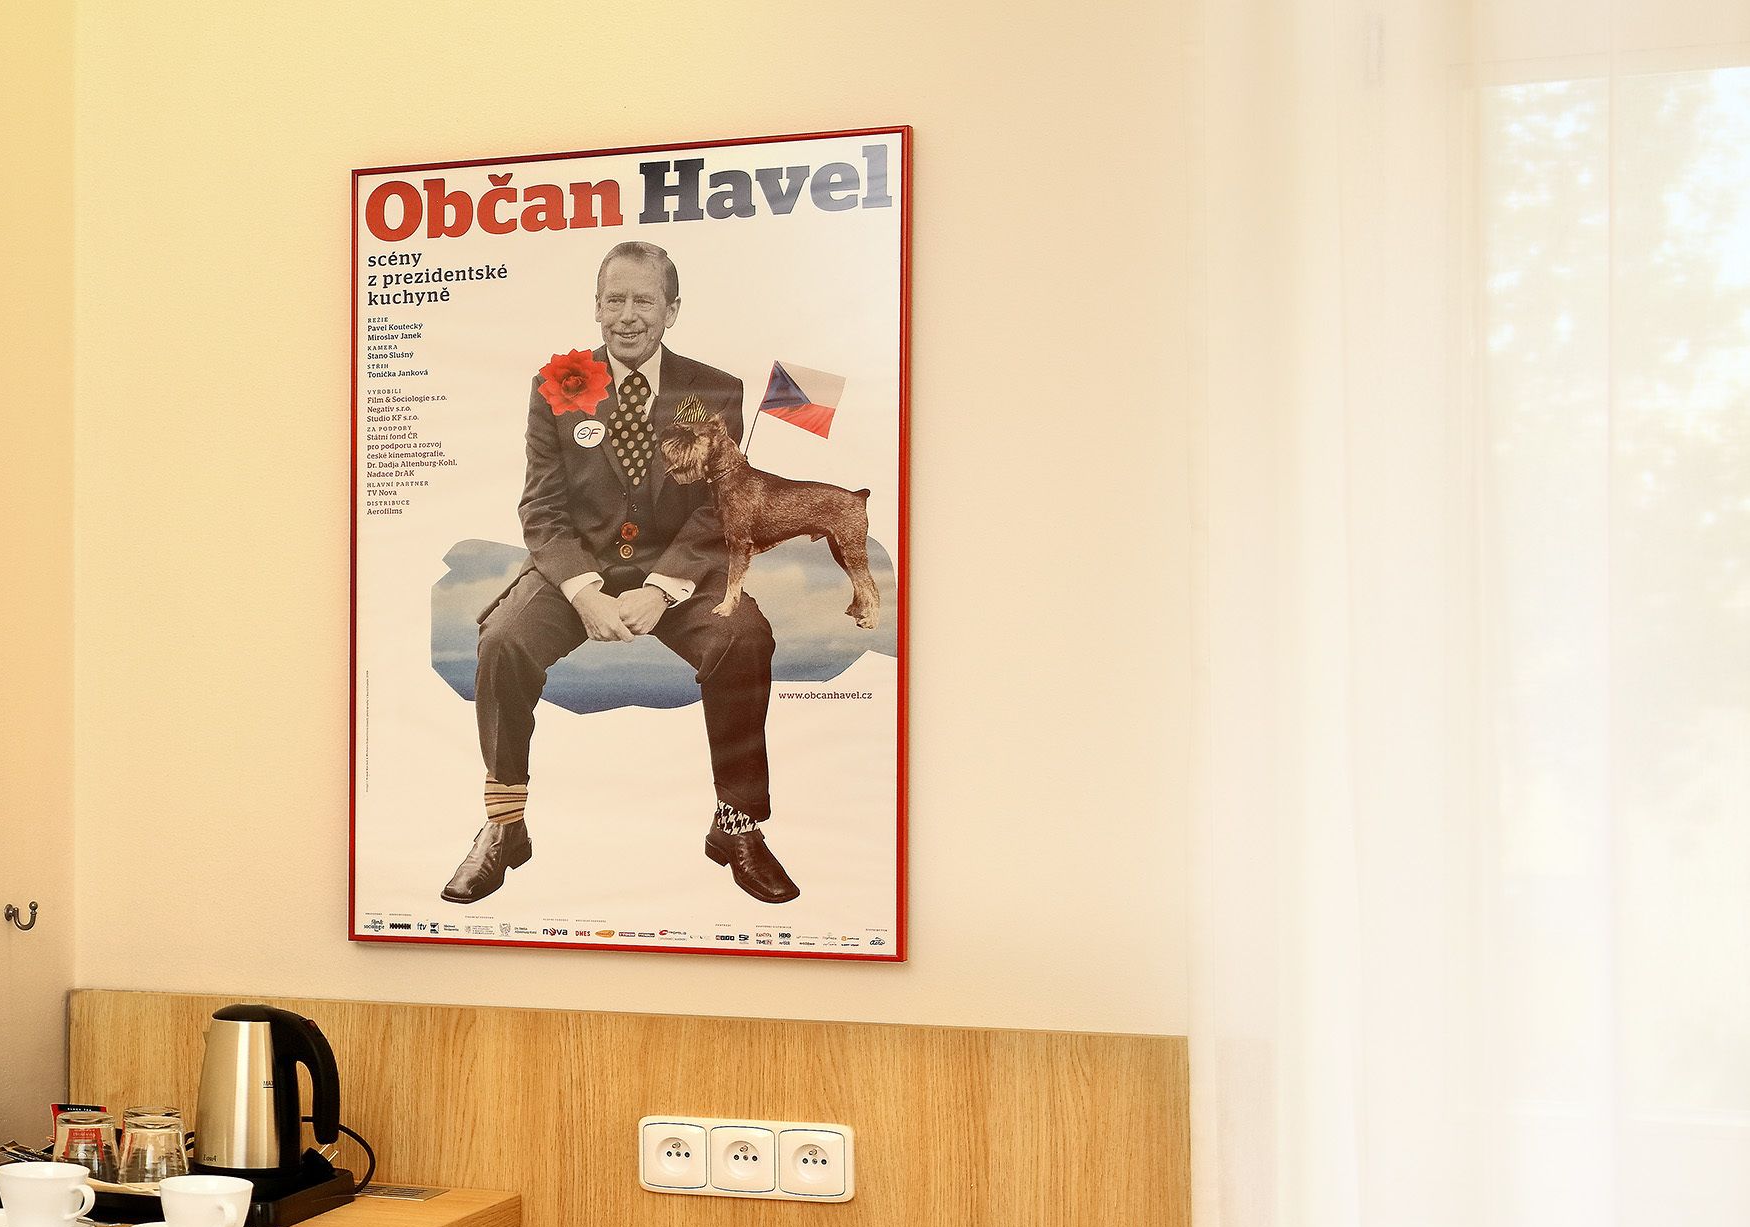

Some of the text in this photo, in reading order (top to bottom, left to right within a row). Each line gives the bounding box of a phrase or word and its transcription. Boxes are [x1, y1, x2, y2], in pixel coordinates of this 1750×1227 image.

[365, 144, 893, 242] Občan Havel
[367, 252, 422, 267] scény
[367, 264, 508, 288] z prezidentské
[367, 287, 450, 306] kuchyně
[388, 323, 423, 331] Koutecký
[367, 333, 399, 341] Miroslav
[389, 351, 414, 359] Slušný
[398, 369, 429, 377] Janková
[392, 395, 430, 403] Sociologie
[367, 406, 394, 414] Negativ
[367, 433, 388, 441] Státní
[407, 431, 418, 439] ČR
[418, 441, 442, 449] rozvoj
[378, 461, 399, 469] Dadja
[778, 691, 873, 699] www.obcanhavel.cz
